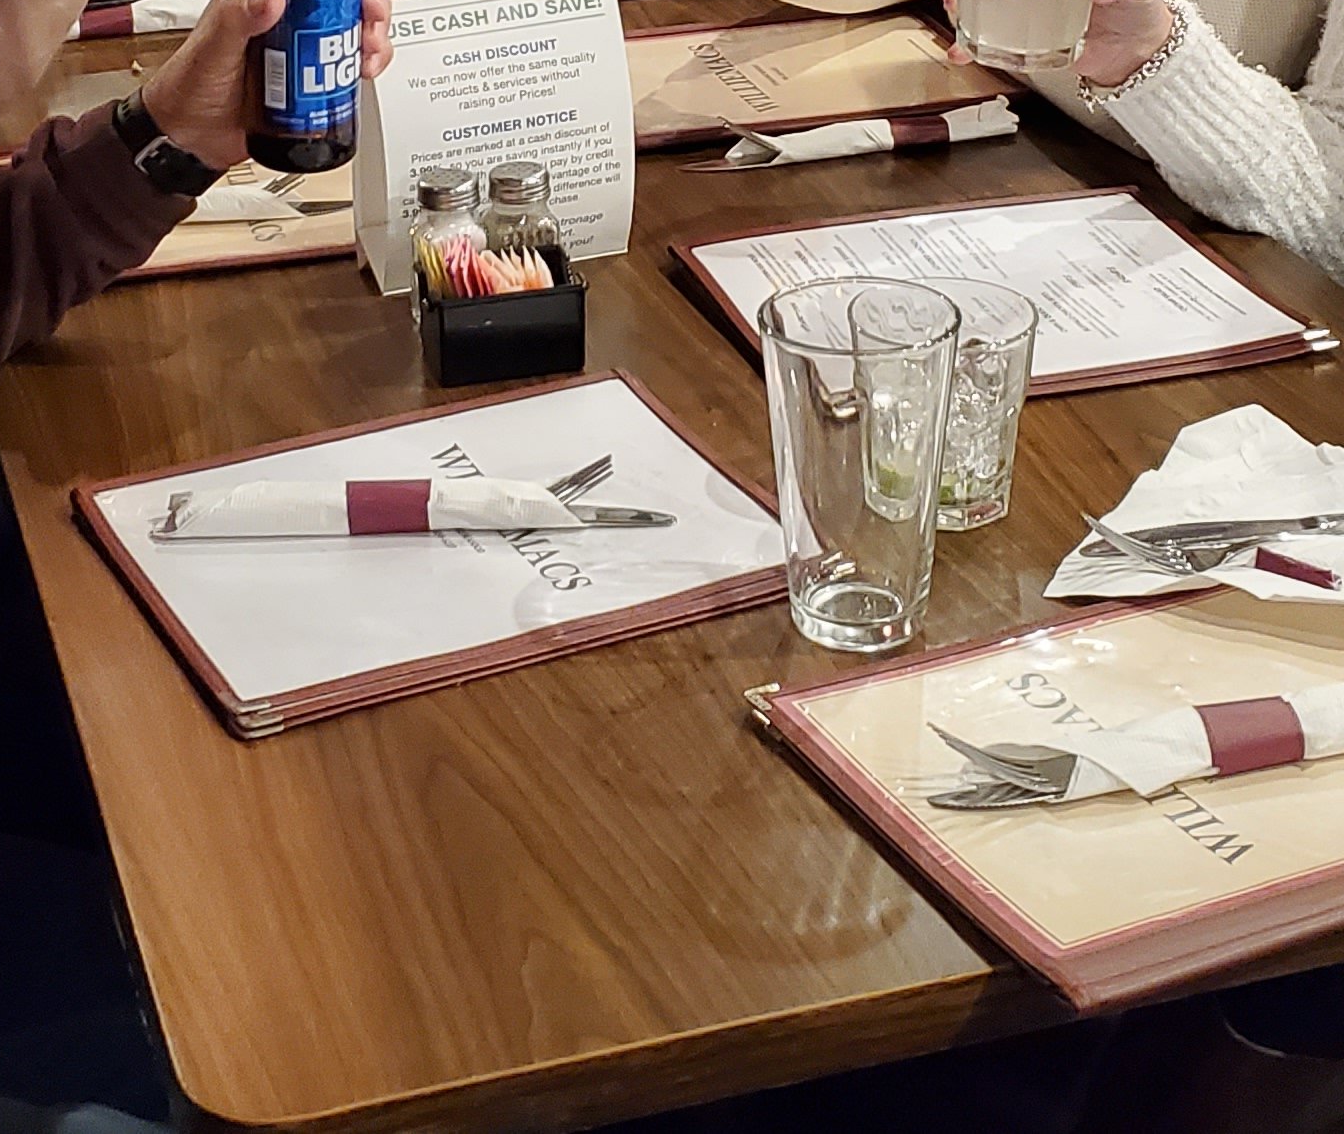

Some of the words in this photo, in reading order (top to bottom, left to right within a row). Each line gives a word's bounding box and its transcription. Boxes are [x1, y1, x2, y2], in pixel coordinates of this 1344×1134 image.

[432, 9, 489, 33] CASH
[496, 2, 538, 24] AND
[319, 21, 360, 64] BU
[442, 48, 482, 67] CASH
[485, 39, 558, 60] DISCOUNT
[303, 50, 361, 94] LIG
[408, 77, 427, 90] We
[430, 75, 451, 87] can
[454, 72, 477, 83] now
[480, 65, 505, 78] offer
[507, 62, 526, 74] the
[528, 59, 558, 71] same
[560, 51, 597, 67] quality
[429, 83, 480, 103] products
[482, 81, 490, 92] &
[493, 74, 538, 90] services
[541, 67, 581, 83] without
[458, 96, 496, 112] raising
[499, 93, 516, 105] our
[519, 87, 556, 101] Prices!
[442, 118, 522, 142] CUSTOMER
[526, 109, 577, 129] NOTICE
[411, 152, 443, 165] Prices
[446, 148, 463, 159] are
[465, 140, 503, 155] marked
[505, 138, 516, 148] at
[519, 137, 525, 146] a
[527, 132, 552, 145] cash
[554, 125, 597, 140] discount
[599, 122, 611, 133] of
[465, 159, 484, 170] you
[486, 155, 503, 165] are
[505, 148, 538, 163] saving
[541, 140, 582, 155] instantly
[584, 137, 591, 148] if
[593, 136, 612, 148] you
[550, 157, 568, 169] pay
[570, 154, 583, 165] by
[585, 148, 614, 161] credit
[551, 167, 590, 180] vantage
[592, 163, 602, 173] of
[605, 160, 621, 171] the
[553, 177, 602, 193] difference
[605, 172, 621, 184] will
[548, 193, 579, 206] chase
[560, 212, 604, 227] tronage
